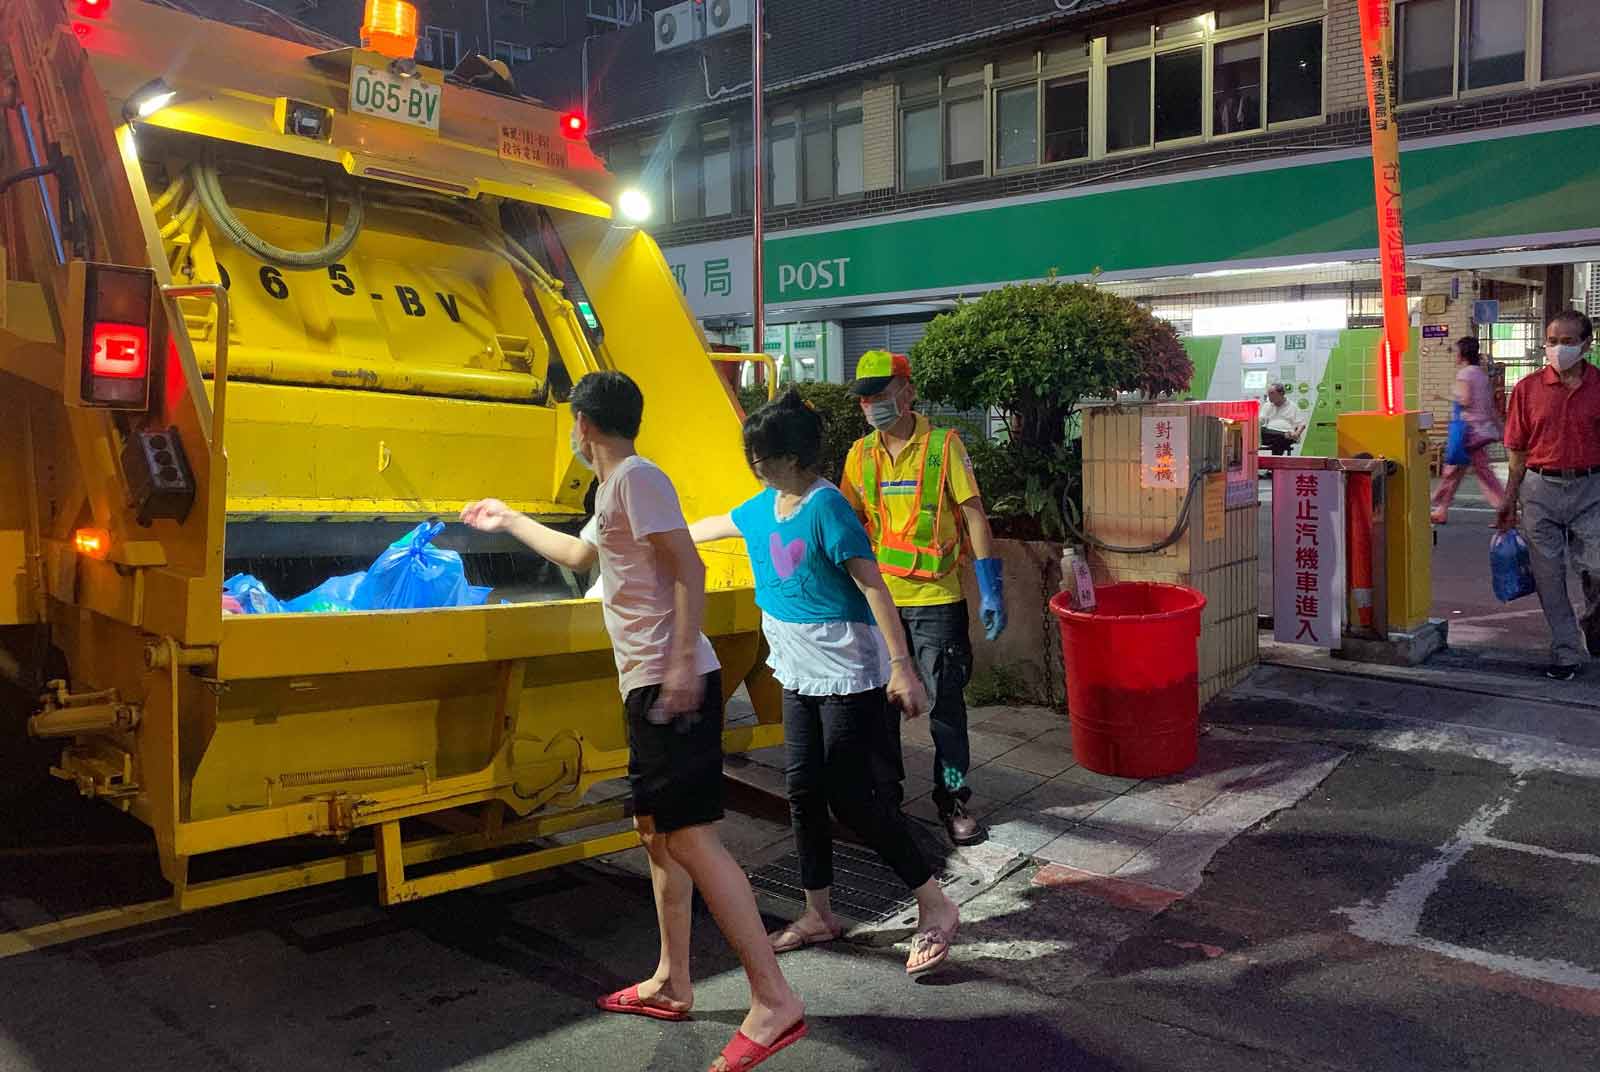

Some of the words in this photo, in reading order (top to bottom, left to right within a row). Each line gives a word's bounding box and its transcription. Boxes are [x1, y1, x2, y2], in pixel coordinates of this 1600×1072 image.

[356, 76, 438, 122] 065-BV
[779, 257, 851, 294] POST
[1295, 474, 1319, 643] 禁止汽機車進入
